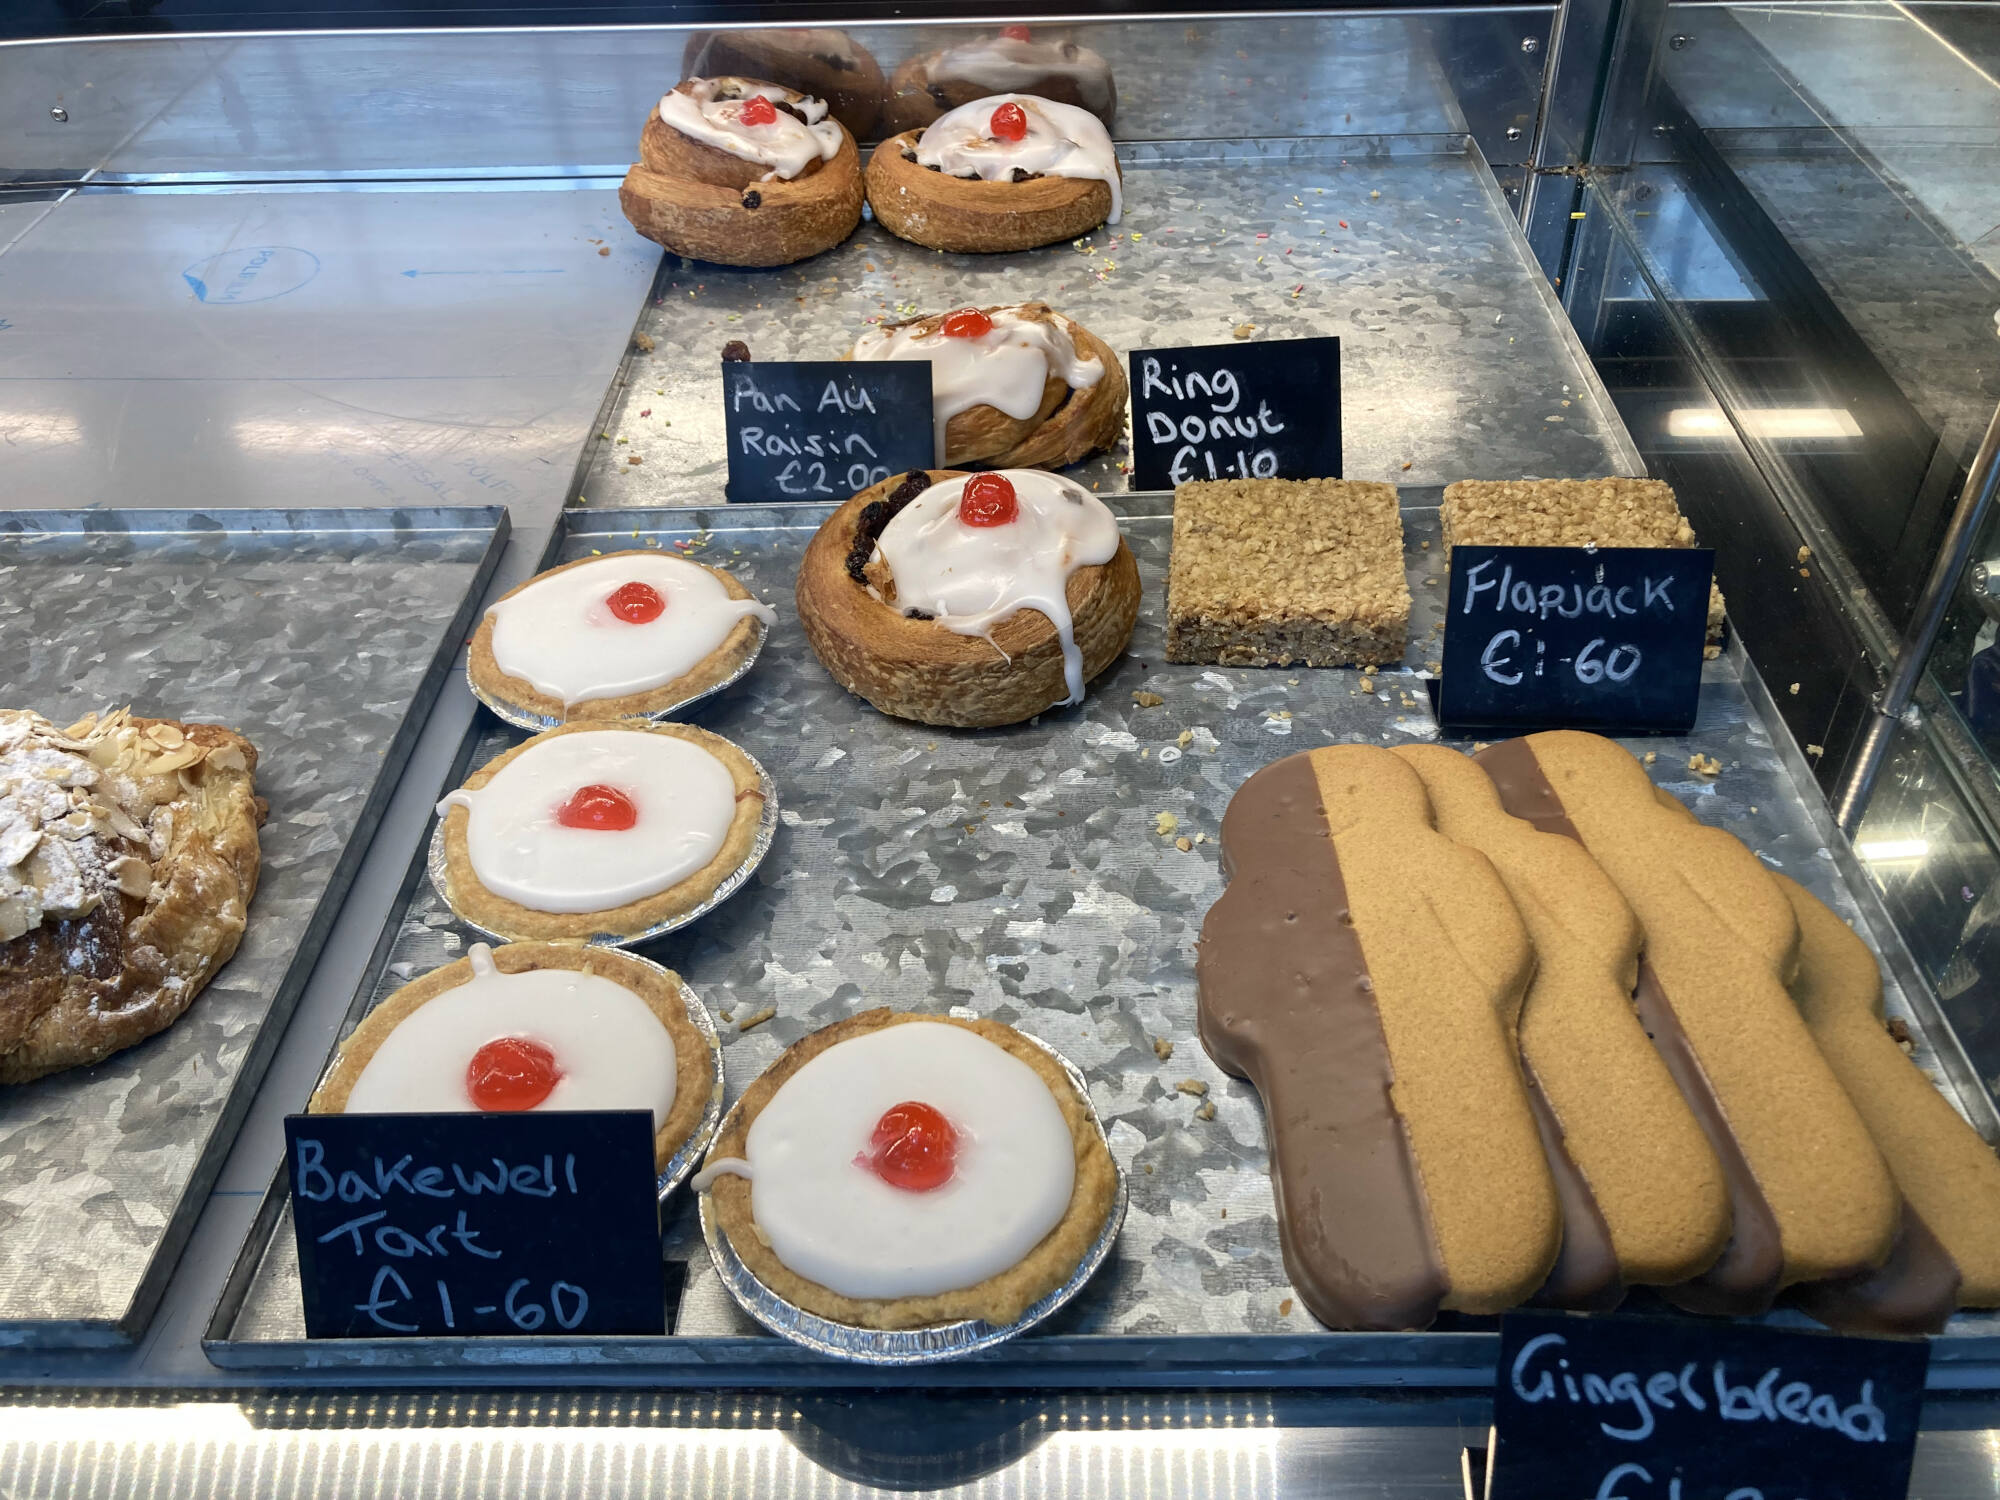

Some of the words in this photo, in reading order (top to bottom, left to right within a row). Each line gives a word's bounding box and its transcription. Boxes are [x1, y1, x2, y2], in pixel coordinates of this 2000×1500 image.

[733, 373, 801, 414] Pan
[817, 379, 876, 414] Au
[1142, 356, 1240, 413] Ring
[740, 423, 878, 458] Raisin
[1146, 399, 1285, 444] Donut
[1463, 555, 1676, 620] Flapjack
[296, 1137, 578, 1201] Bakewell
[316, 1210, 502, 1259] Tart
[1511, 1333, 1887, 1442] Gingerbread
